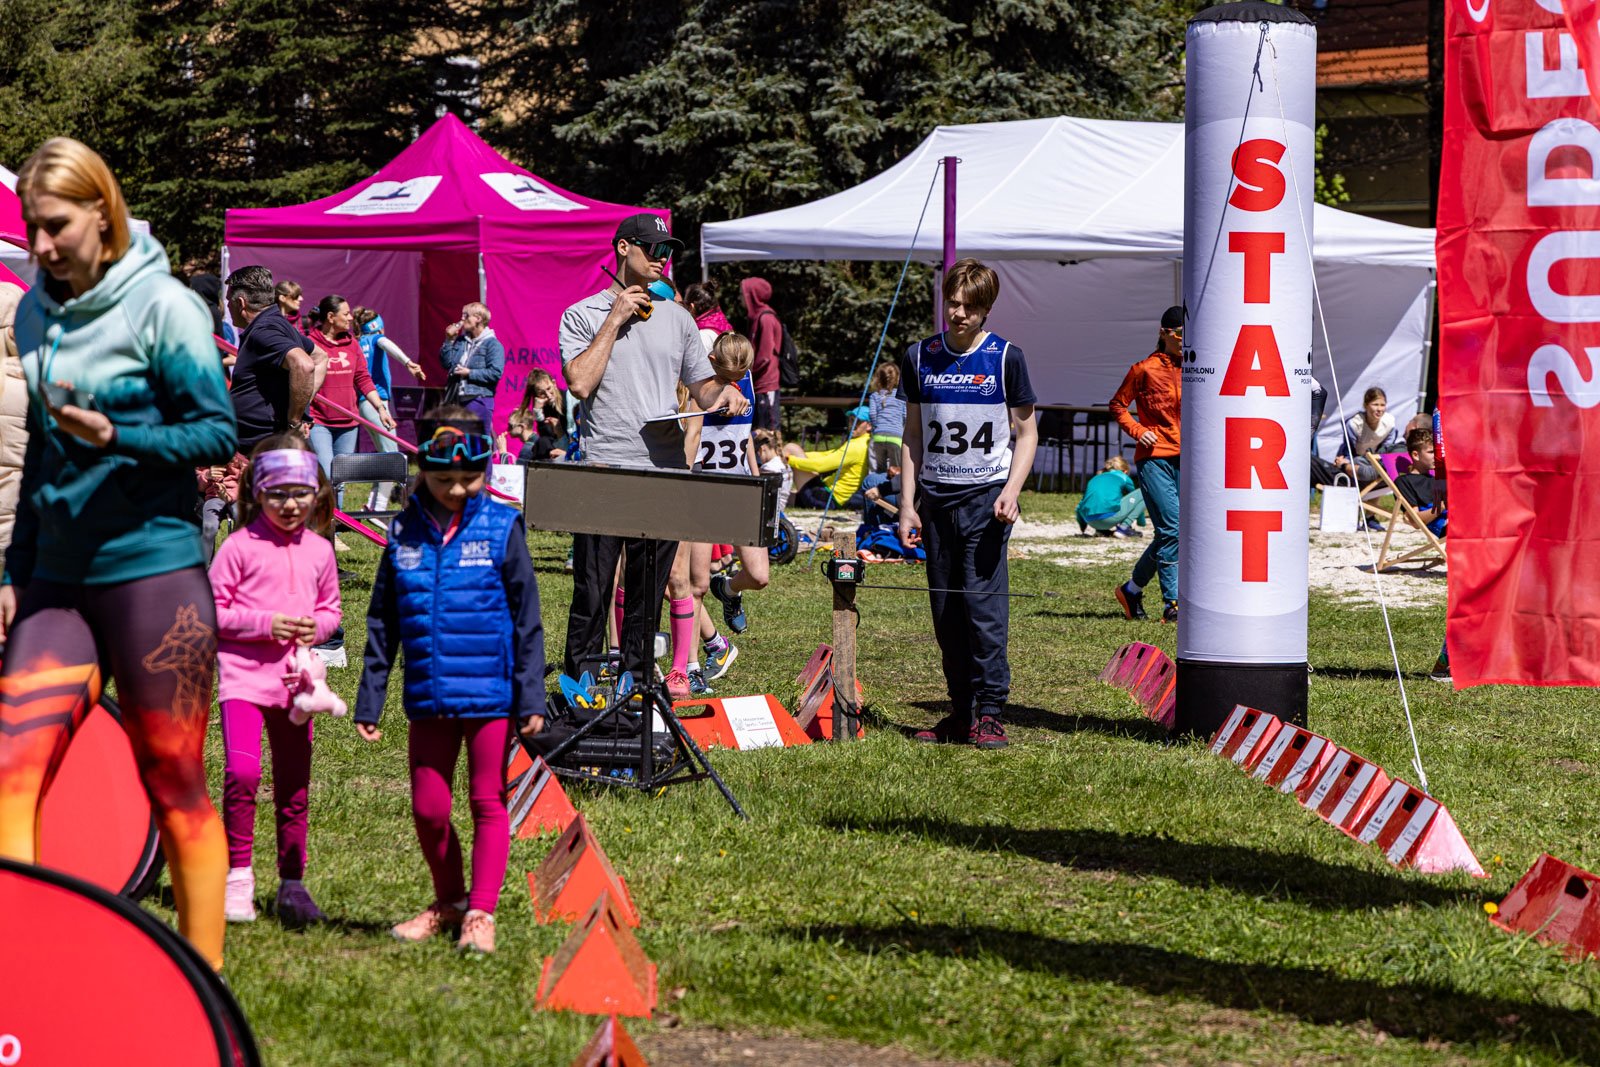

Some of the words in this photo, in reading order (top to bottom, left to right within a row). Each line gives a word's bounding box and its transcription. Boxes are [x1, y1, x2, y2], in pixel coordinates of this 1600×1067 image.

[1219, 138, 1291, 582] START
[924, 374, 996, 384] INCORSA
[928, 420, 994, 455] 234
